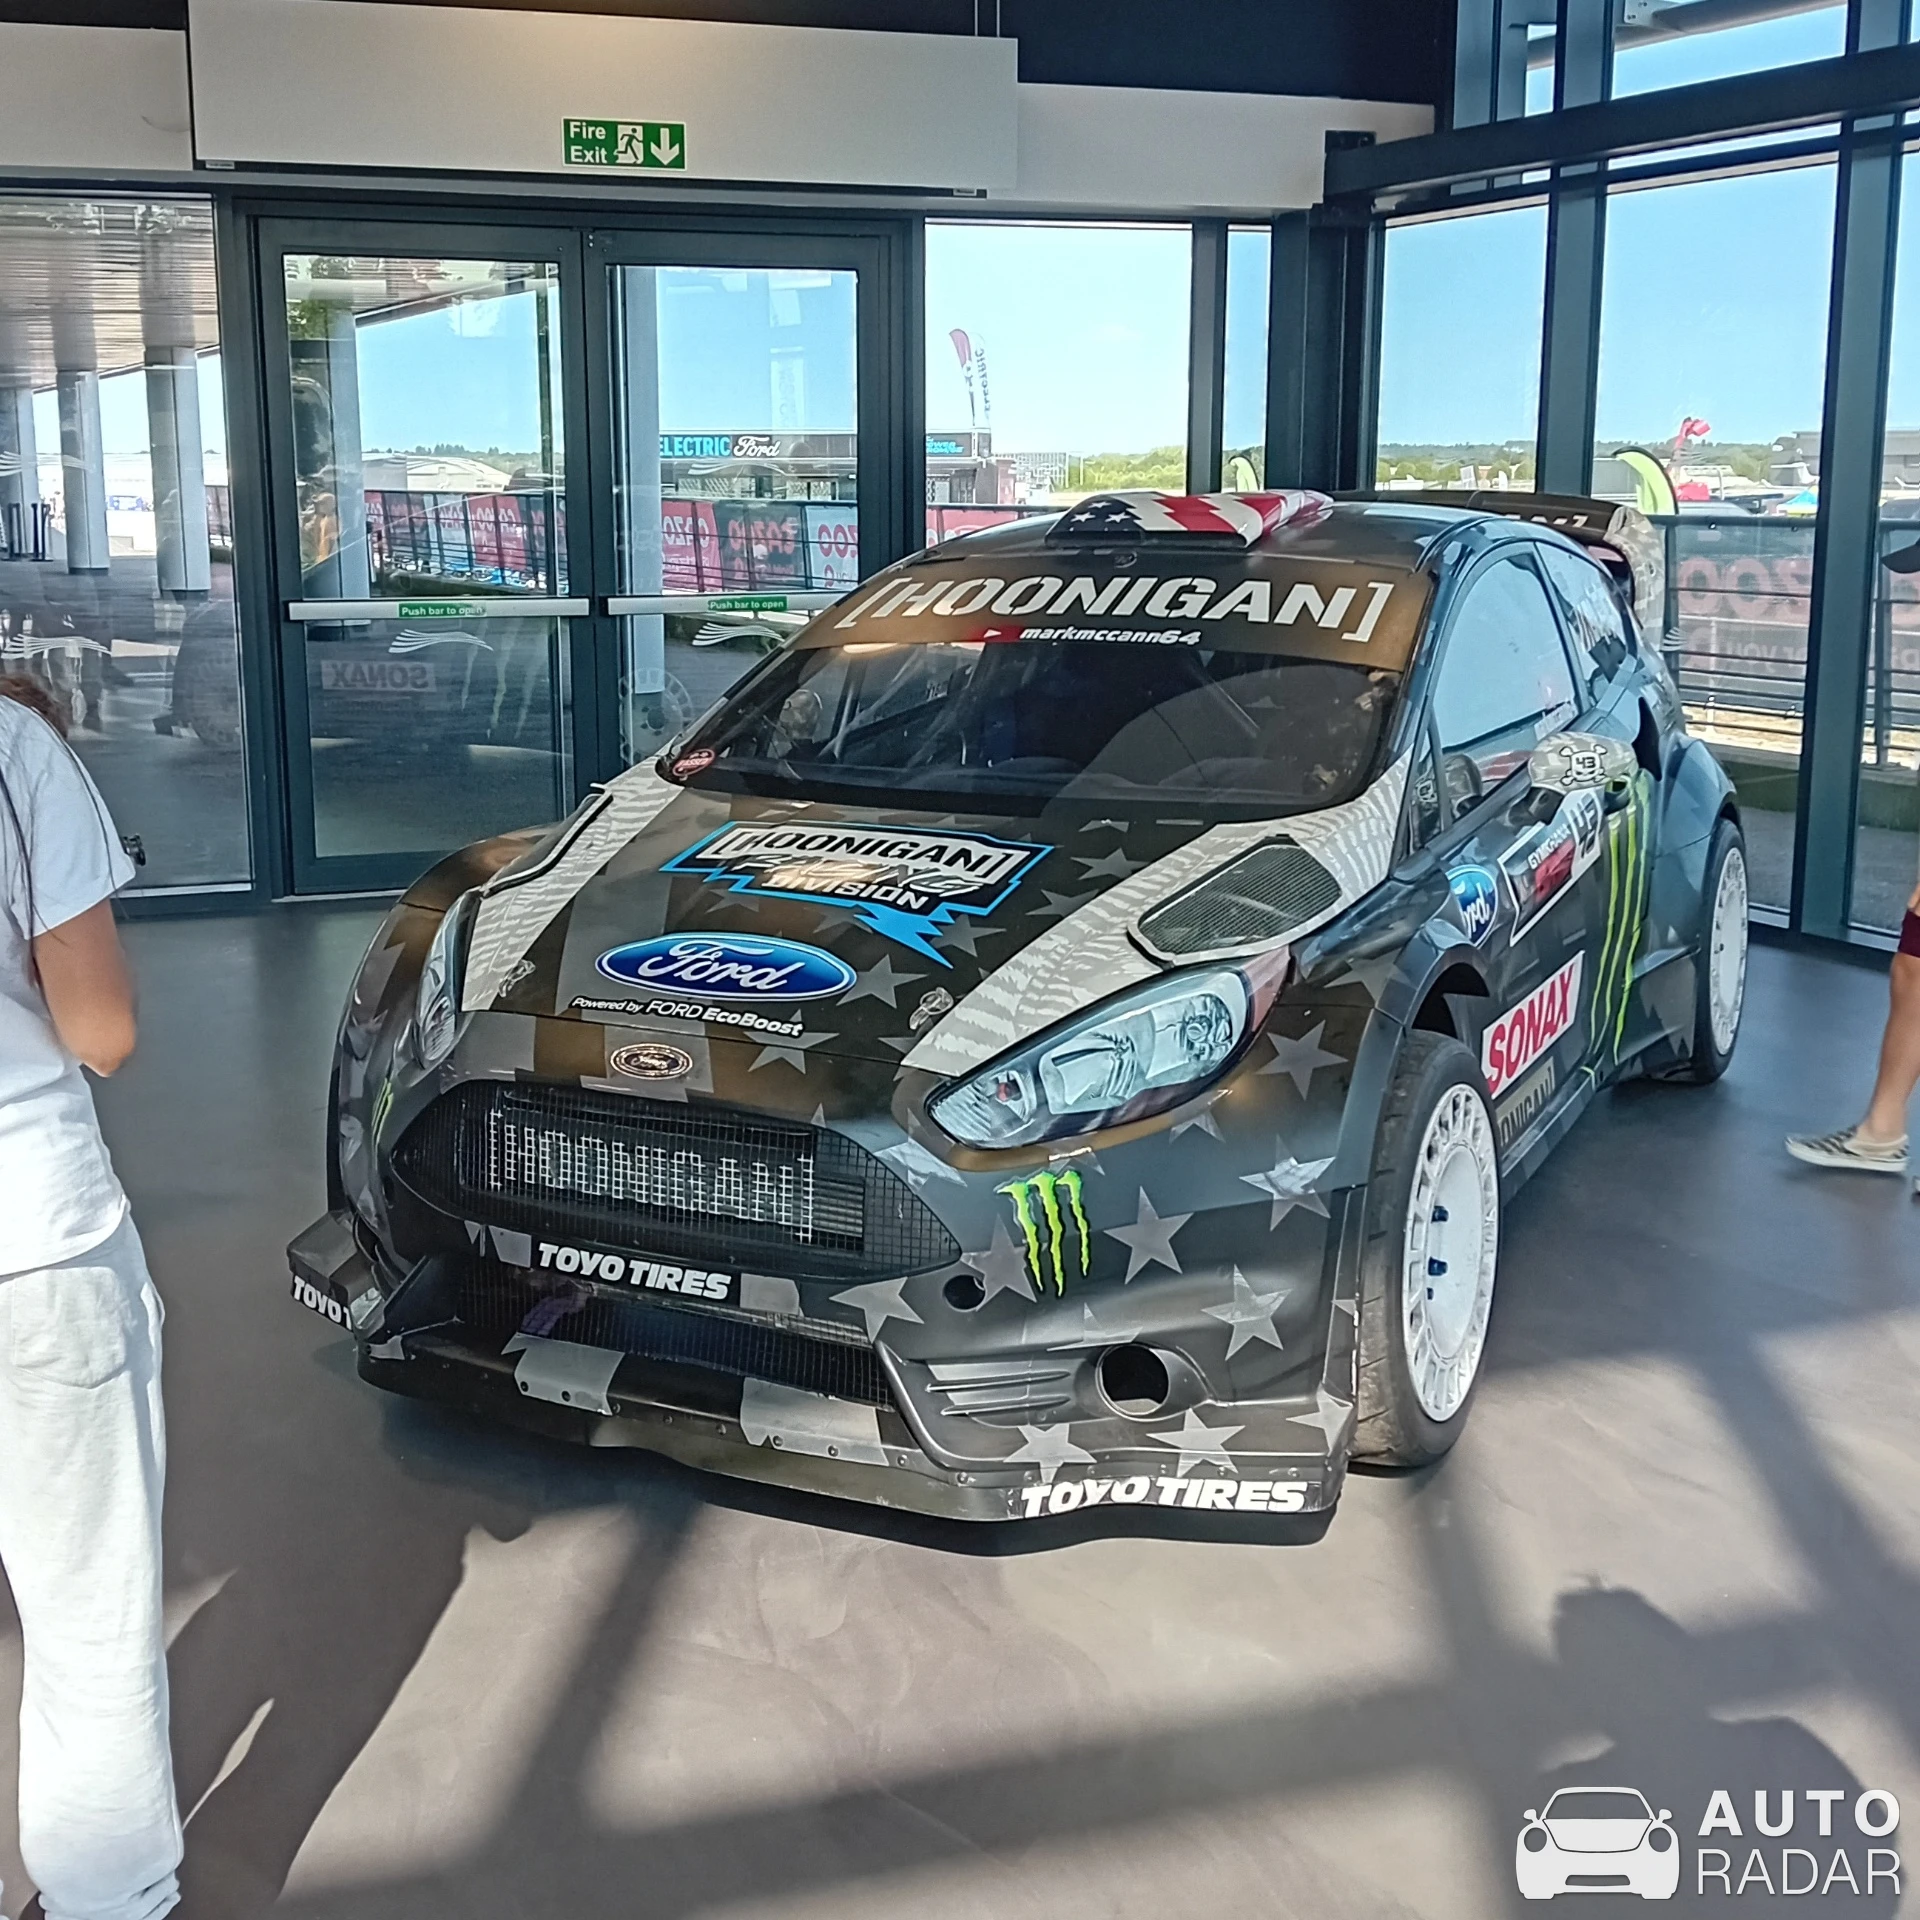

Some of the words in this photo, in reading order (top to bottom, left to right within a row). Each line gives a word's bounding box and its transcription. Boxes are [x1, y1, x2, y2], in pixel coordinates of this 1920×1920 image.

[569, 121, 606, 139] Fire
[570, 145, 607, 163] Exit
[733, 435, 781, 457] Ford
[402, 606, 426, 616] Push
[428, 606, 445, 616] bar
[446, 607, 457, 616] to
[709, 601, 734, 610] Push
[735, 601, 750, 610] bar
[751, 601, 760, 609] to
[762, 602, 784, 610] open
[1019, 625, 1202, 646] markmccann64
[1576, 756, 1595, 769] 43
[761, 872, 930, 910] DIVISION
[637, 939, 801, 991] Ford
[572, 997, 631, 1012] Powered
[627, 1002, 645, 1014] by
[646, 1000, 704, 1019] FORD
[702, 1008, 804, 1037] EcoBoost
[1487, 962, 1576, 1095] SONAX
[539, 1242, 626, 1282] TOYO
[628, 1260, 732, 1300] TIRES
[294, 1275, 342, 1323] TOYO
[1021, 1475, 1152, 1518] TOYO
[1155, 1477, 1307, 1513] TIRES
